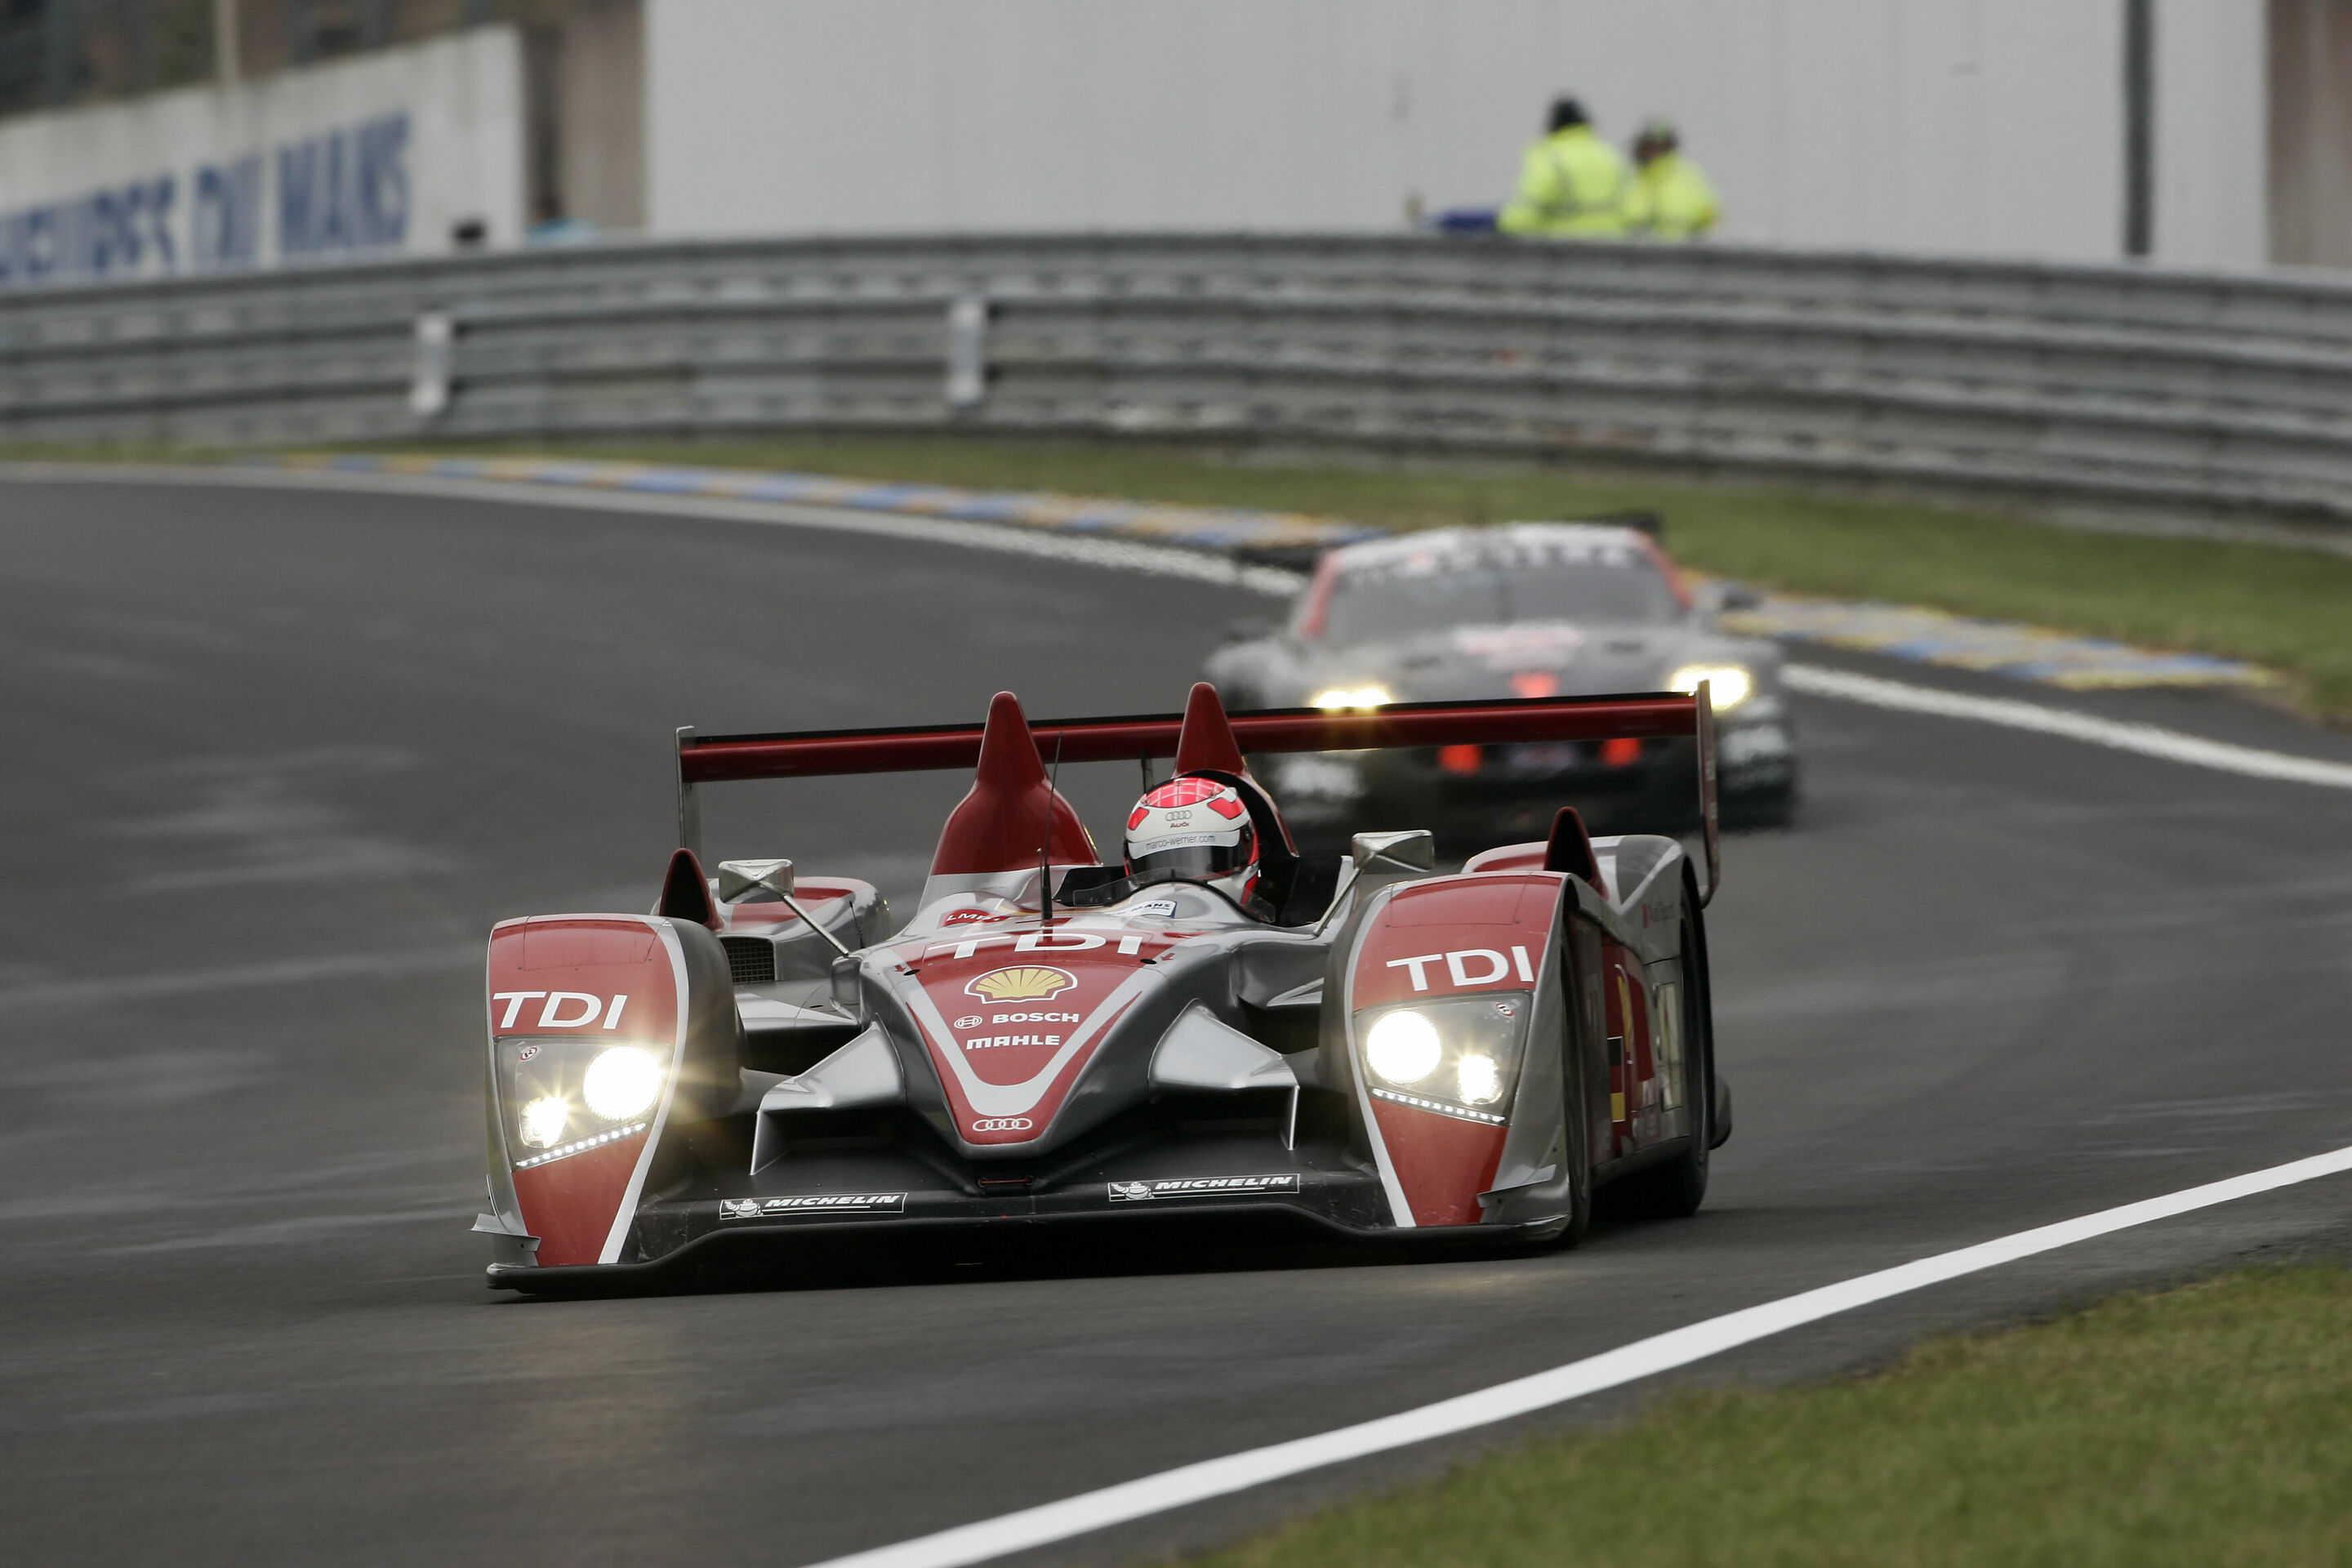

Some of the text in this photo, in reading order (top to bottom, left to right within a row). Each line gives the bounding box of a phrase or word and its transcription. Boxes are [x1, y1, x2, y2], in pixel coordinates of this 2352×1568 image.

[1146, 835, 1216, 850] marco-werner.com
[929, 933, 1143, 960] TDI
[1386, 946, 1535, 992] TDI
[492, 991, 627, 1030] TDI
[992, 1013, 1080, 1024] BOSCH
[966, 1035, 1061, 1050] MAHLE
[1155, 1176, 1293, 1190] MICHELIN
[764, 1195, 900, 1208] MICHELIN
